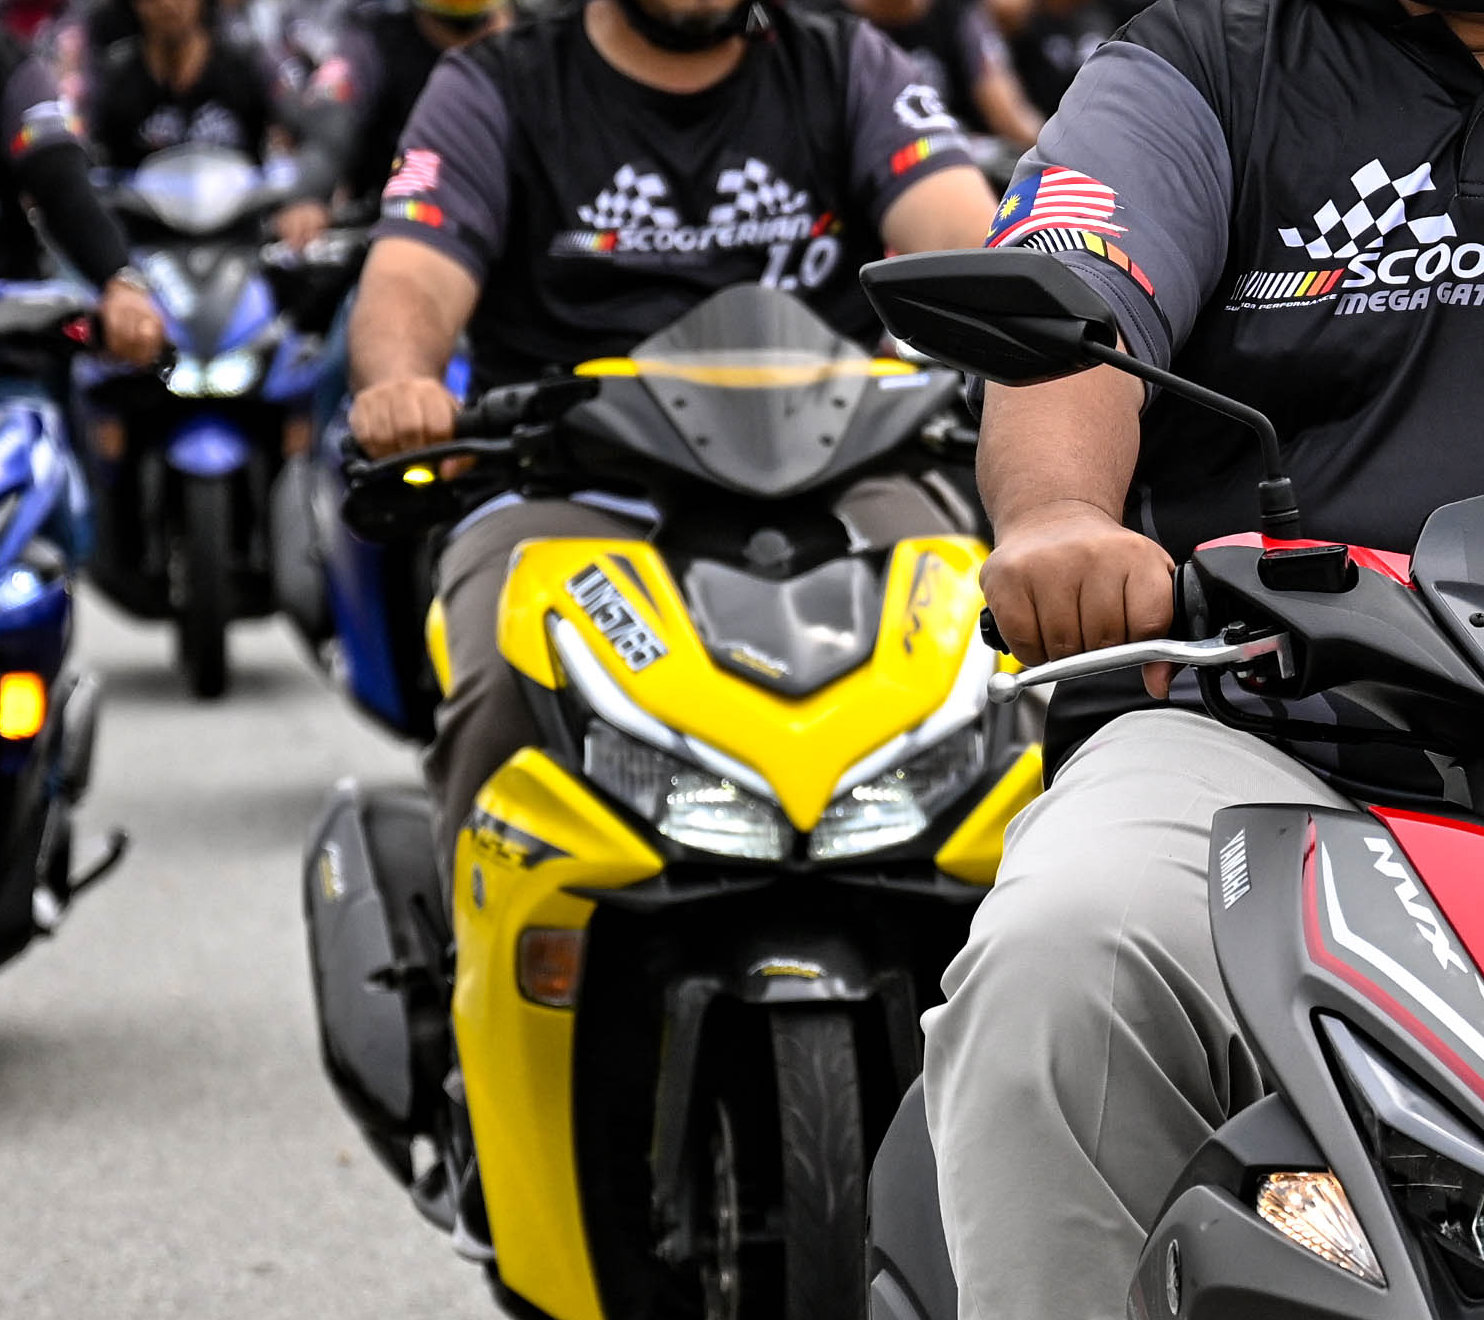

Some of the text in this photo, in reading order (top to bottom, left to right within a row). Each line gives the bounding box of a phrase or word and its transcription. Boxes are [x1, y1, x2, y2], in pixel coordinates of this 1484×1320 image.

[617, 213, 813, 252] SCOOTERIAN
[760, 234, 839, 289] 1.0
[1334, 286, 1431, 316] MEGA
[1219, 827, 1253, 911] YAMAHA
[1363, 836, 1469, 973] NVX
